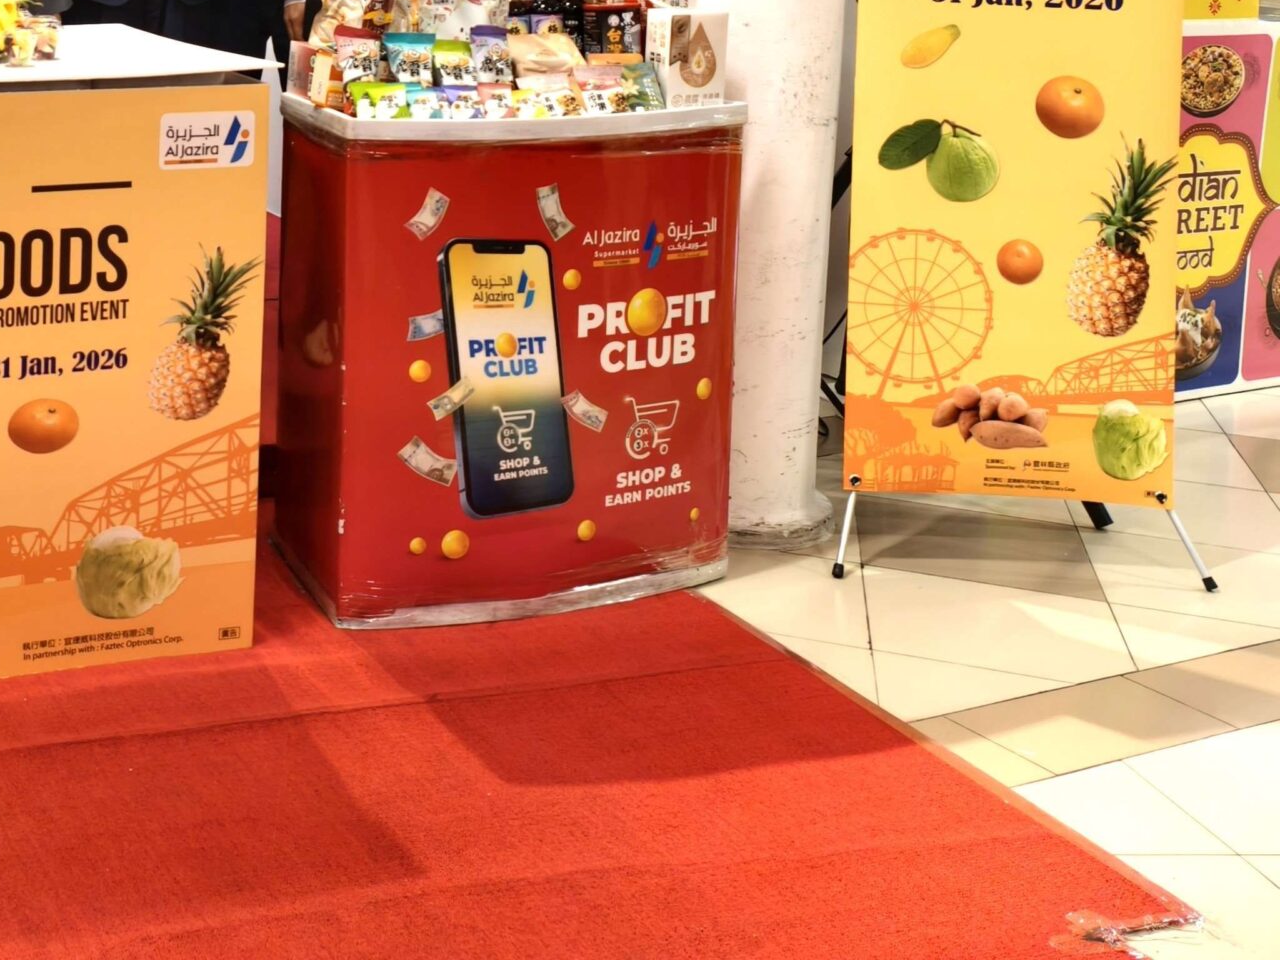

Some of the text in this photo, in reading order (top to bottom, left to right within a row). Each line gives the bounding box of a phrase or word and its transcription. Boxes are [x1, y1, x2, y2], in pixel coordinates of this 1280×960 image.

[166, 124, 220, 142] الجزيرة
[667, 217, 717, 242] الجزيرة
[594, 248, 640, 258] Supermarket
[80, 298, 130, 322] EVENT
[18, 354, 64, 380] Jan,
[71, 347, 128, 373] 2026
[600, 333, 696, 373] CLUB
[484, 358, 538, 378] CLUB
[494, 466, 548, 481] EARN POINTS
[499, 455, 541, 470] SHOP &
[616, 463, 682, 488] SHOP &
[605, 481, 692, 507] EARN POINTS
[23, 653, 31, 661] In
[32, 647, 77, 661] partnership
[78, 644, 95, 654] with
